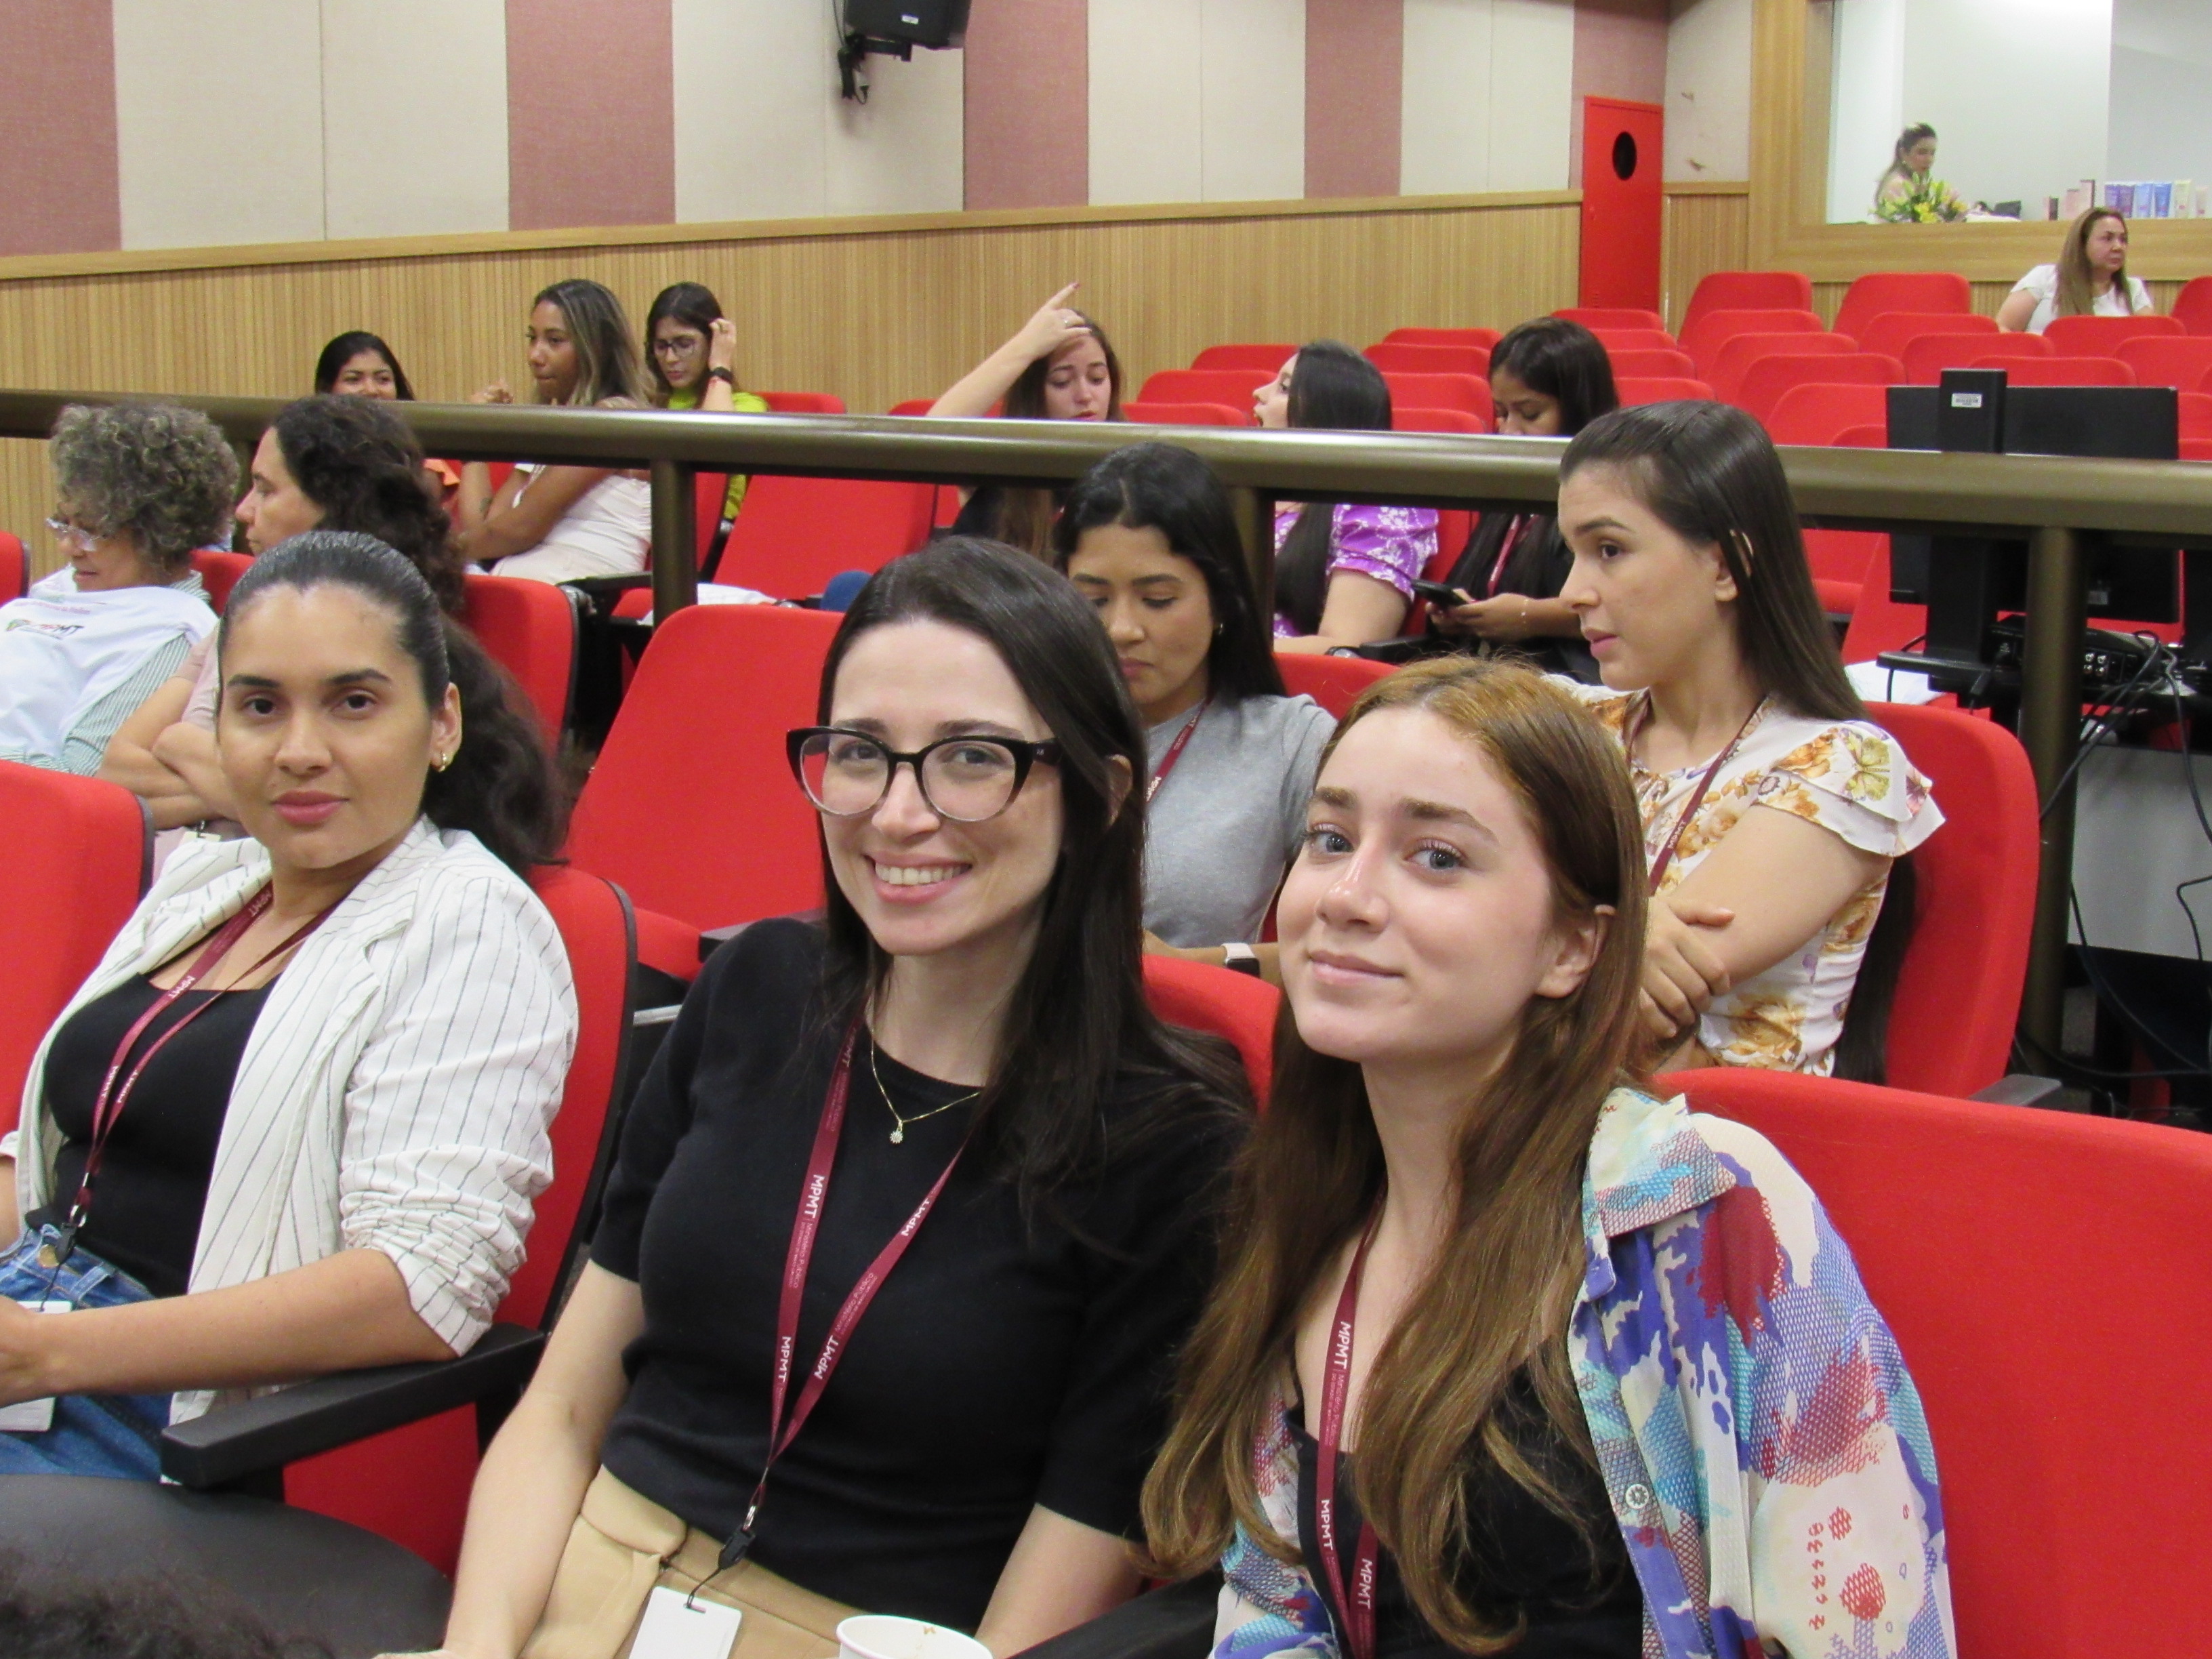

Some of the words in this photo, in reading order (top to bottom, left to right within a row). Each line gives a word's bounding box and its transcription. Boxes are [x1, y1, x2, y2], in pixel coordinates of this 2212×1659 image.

[1667, 819, 1687, 849] MPMT
[169, 975, 196, 999] MPMT
[804, 1174, 825, 1218] MPMT
[901, 1197, 930, 1236] MPMT
[778, 1336, 792, 1382] MPMT
[813, 1335, 839, 1380] MPMT
[1334, 1322, 1352, 1370] MPMT
[1322, 1499, 1333, 1551] MPMT
[1358, 1558, 1373, 1610] MPMT
